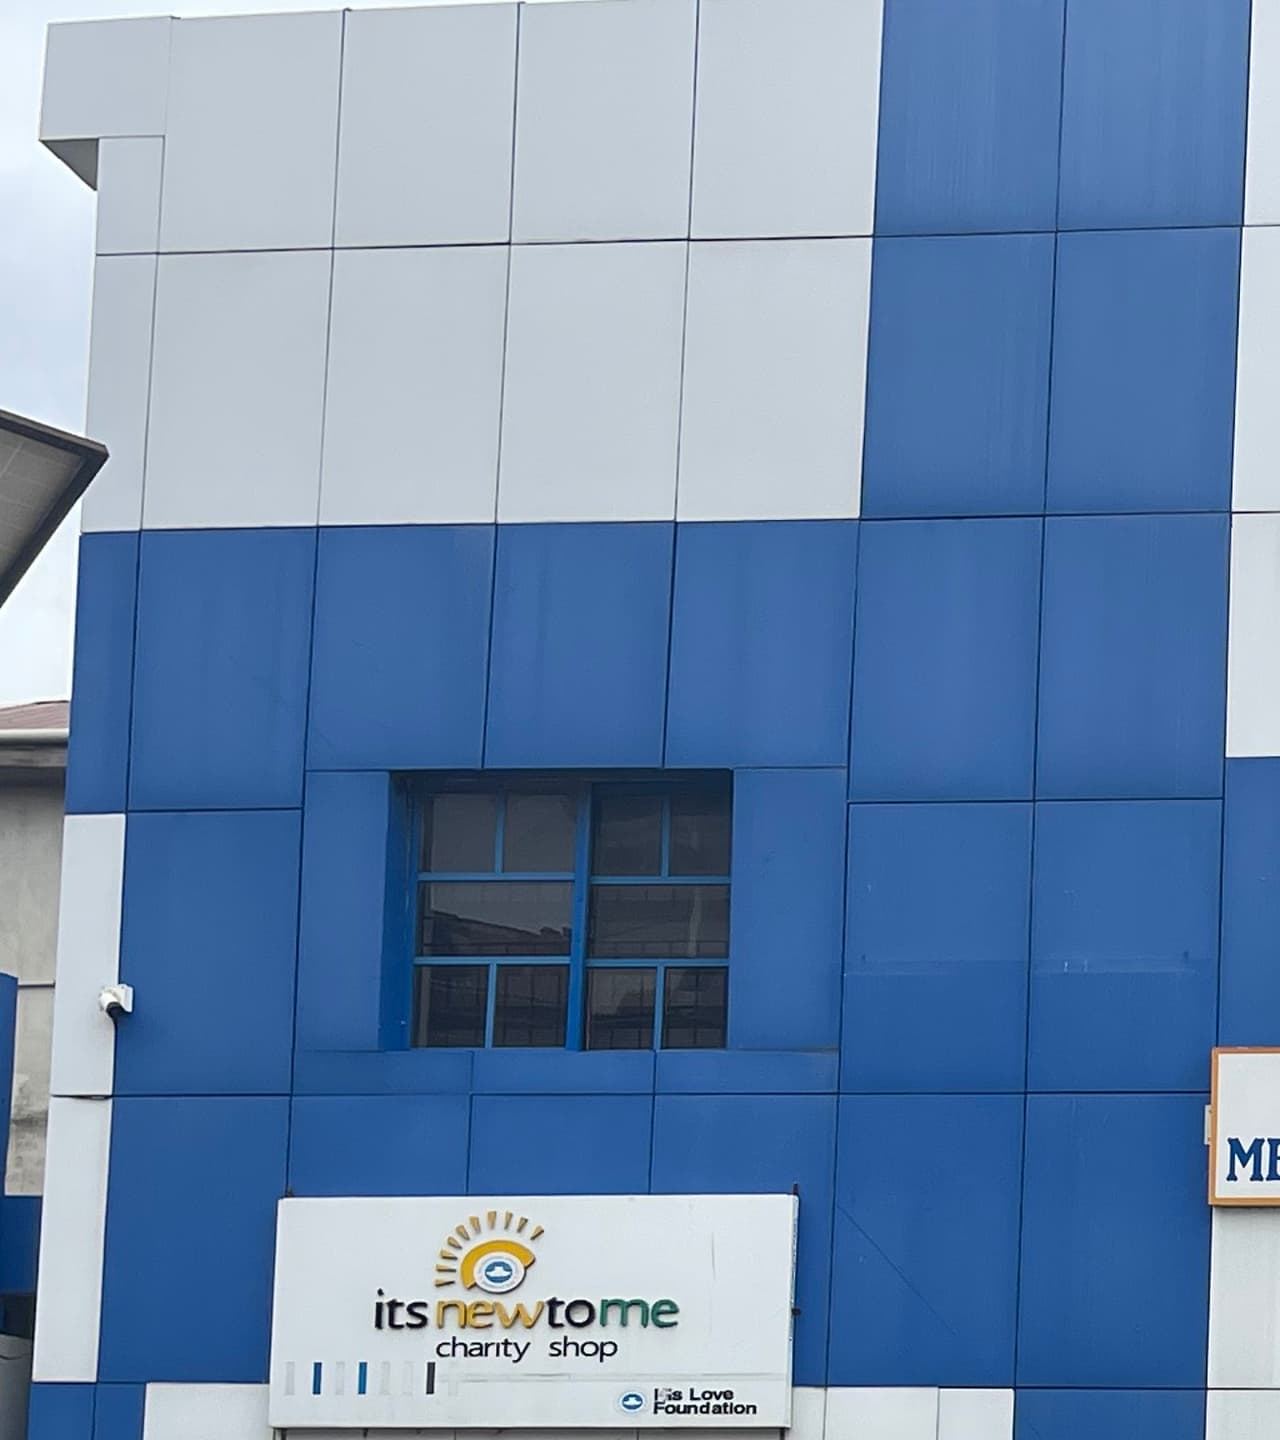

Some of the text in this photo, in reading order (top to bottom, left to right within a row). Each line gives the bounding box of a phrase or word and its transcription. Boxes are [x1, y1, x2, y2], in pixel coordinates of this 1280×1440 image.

[436, 1336, 619, 1363] charity shop
[689, 1387, 735, 1402] Love
[653, 1401, 758, 1415] Foundation
